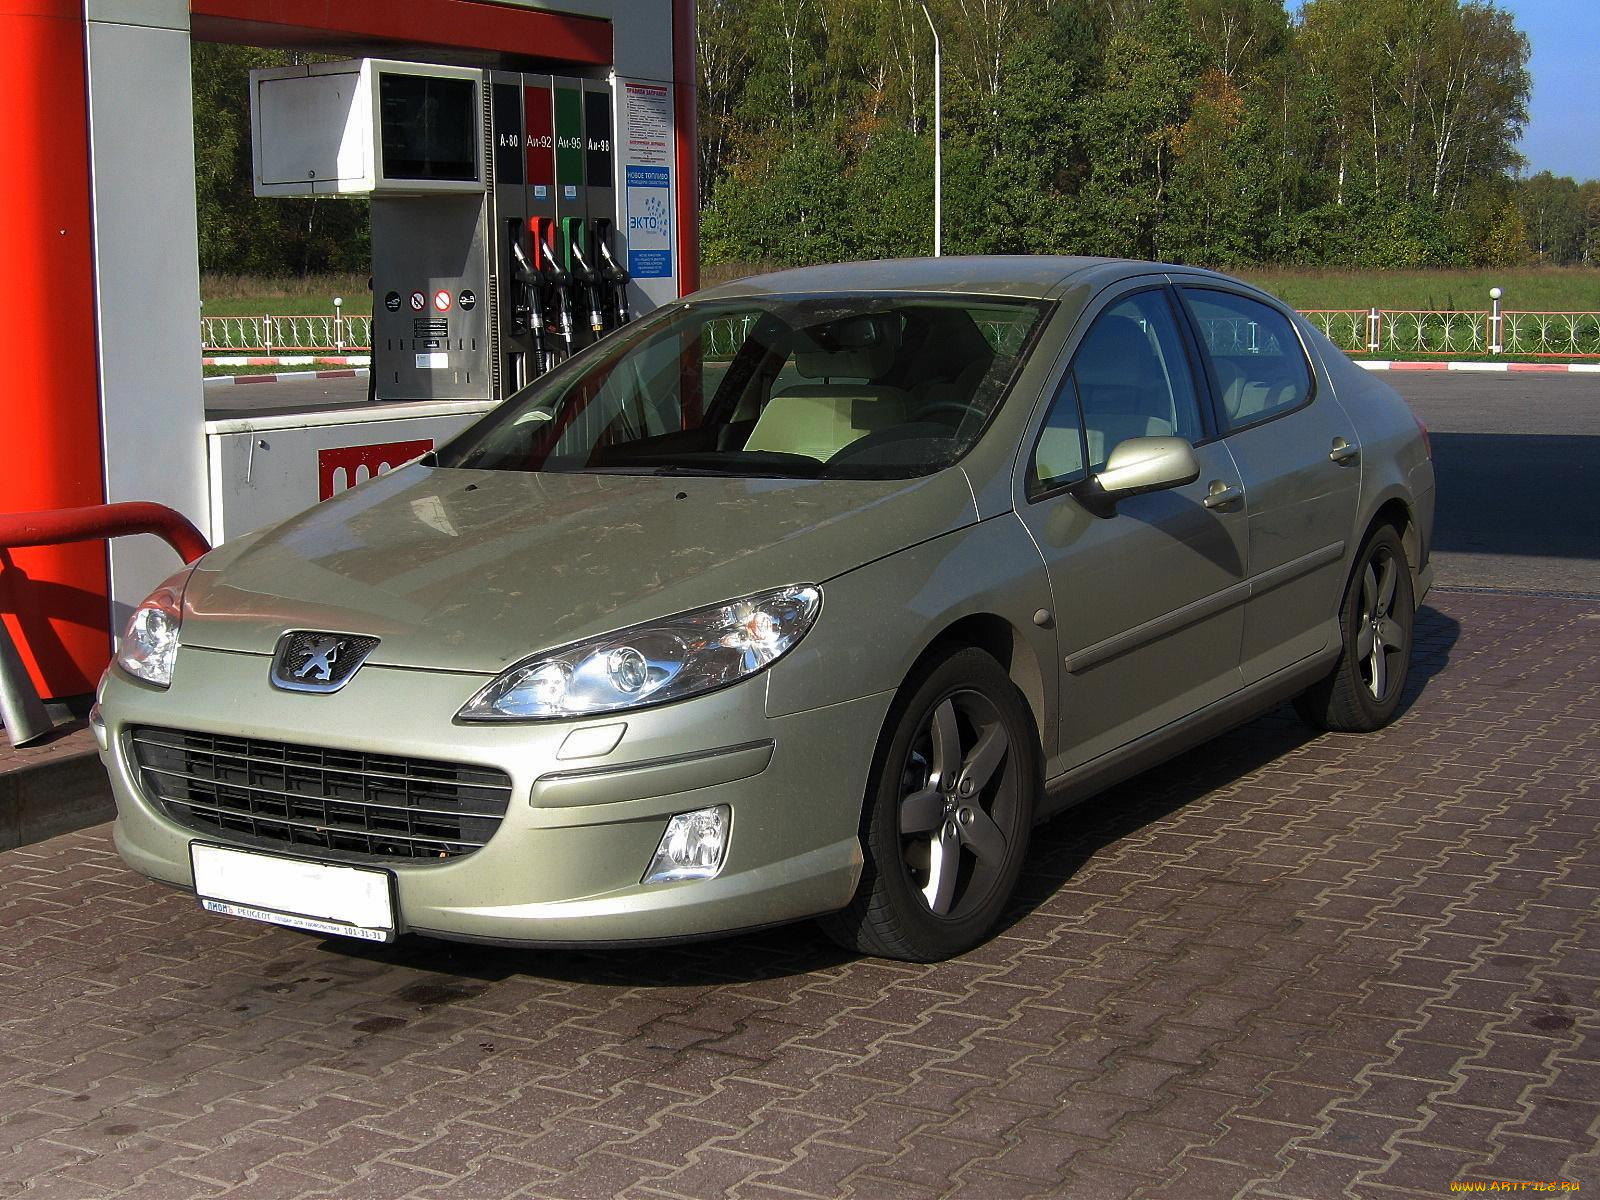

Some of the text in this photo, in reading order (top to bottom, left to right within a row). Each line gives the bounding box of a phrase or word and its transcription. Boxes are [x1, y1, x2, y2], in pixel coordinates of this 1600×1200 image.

[500, 134, 518, 147] А-80
[526, 135, 552, 148] Аи-92
[557, 137, 582, 150] Аи-95
[588, 138, 610, 152] Аи-98
[630, 216, 657, 229] ЭКТО
[237, 908, 271, 920] PEUGEOT
[344, 927, 381, 940] 101-31-31
